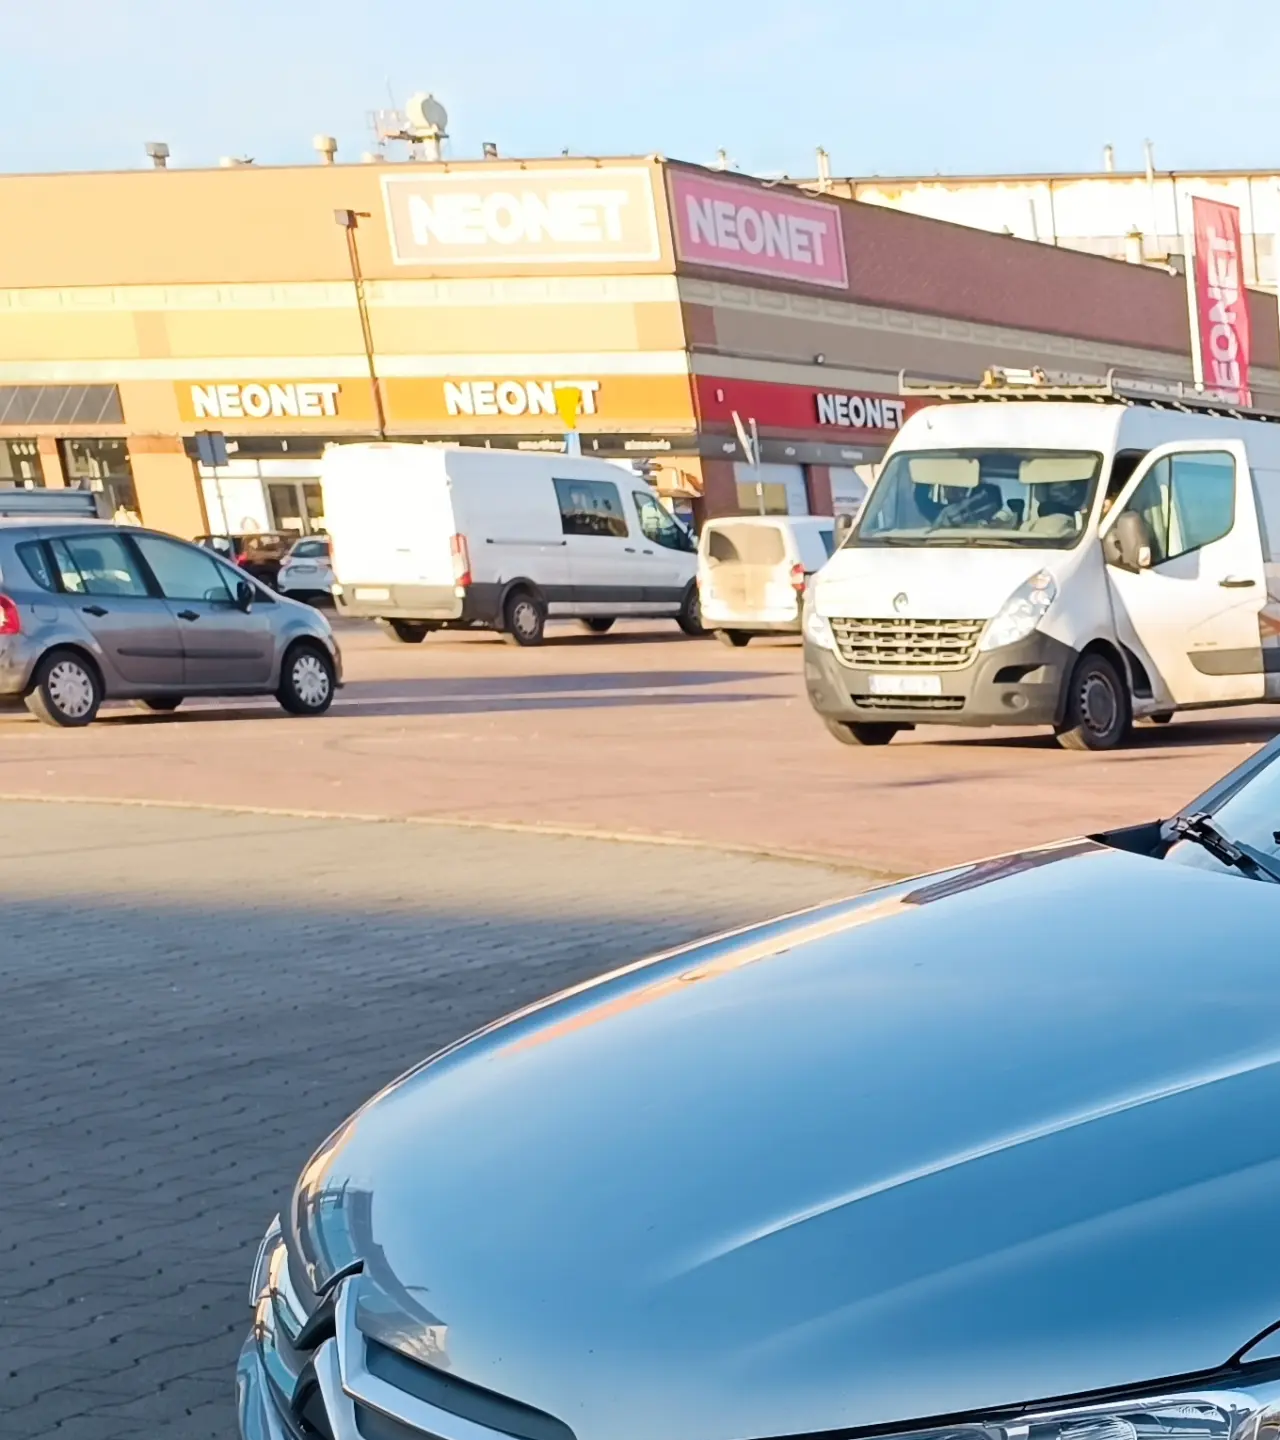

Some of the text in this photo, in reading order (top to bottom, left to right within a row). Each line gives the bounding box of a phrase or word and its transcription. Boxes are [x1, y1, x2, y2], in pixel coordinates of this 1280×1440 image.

[408, 188, 629, 245] NEONET
[687, 195, 827, 266] NEONET
[190, 382, 341, 418] NEONET
[816, 392, 906, 429] NEONET
